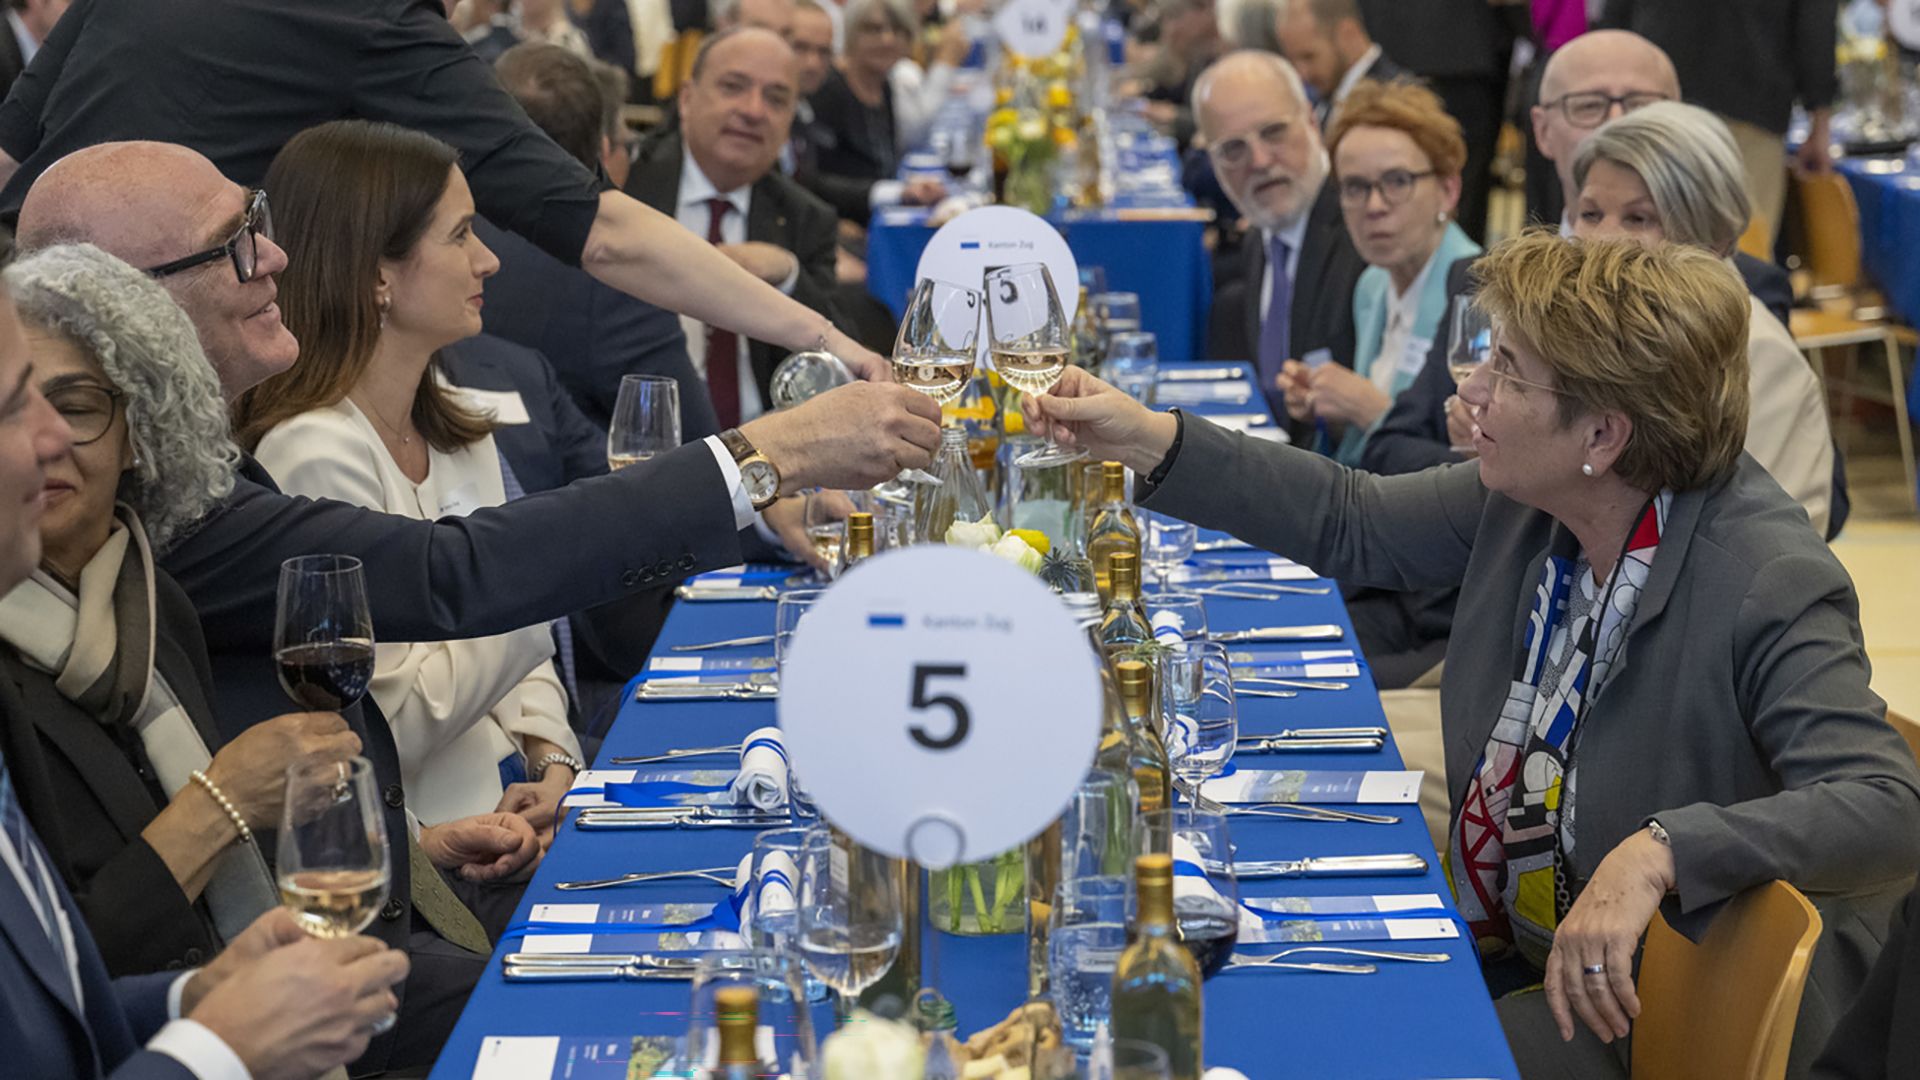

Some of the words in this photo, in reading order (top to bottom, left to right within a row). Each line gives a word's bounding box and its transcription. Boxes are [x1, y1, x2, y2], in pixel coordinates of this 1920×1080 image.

[988, 241, 1017, 249] Kanton
[1019, 241, 1034, 250] Zug
[908, 662, 970, 750] 5
